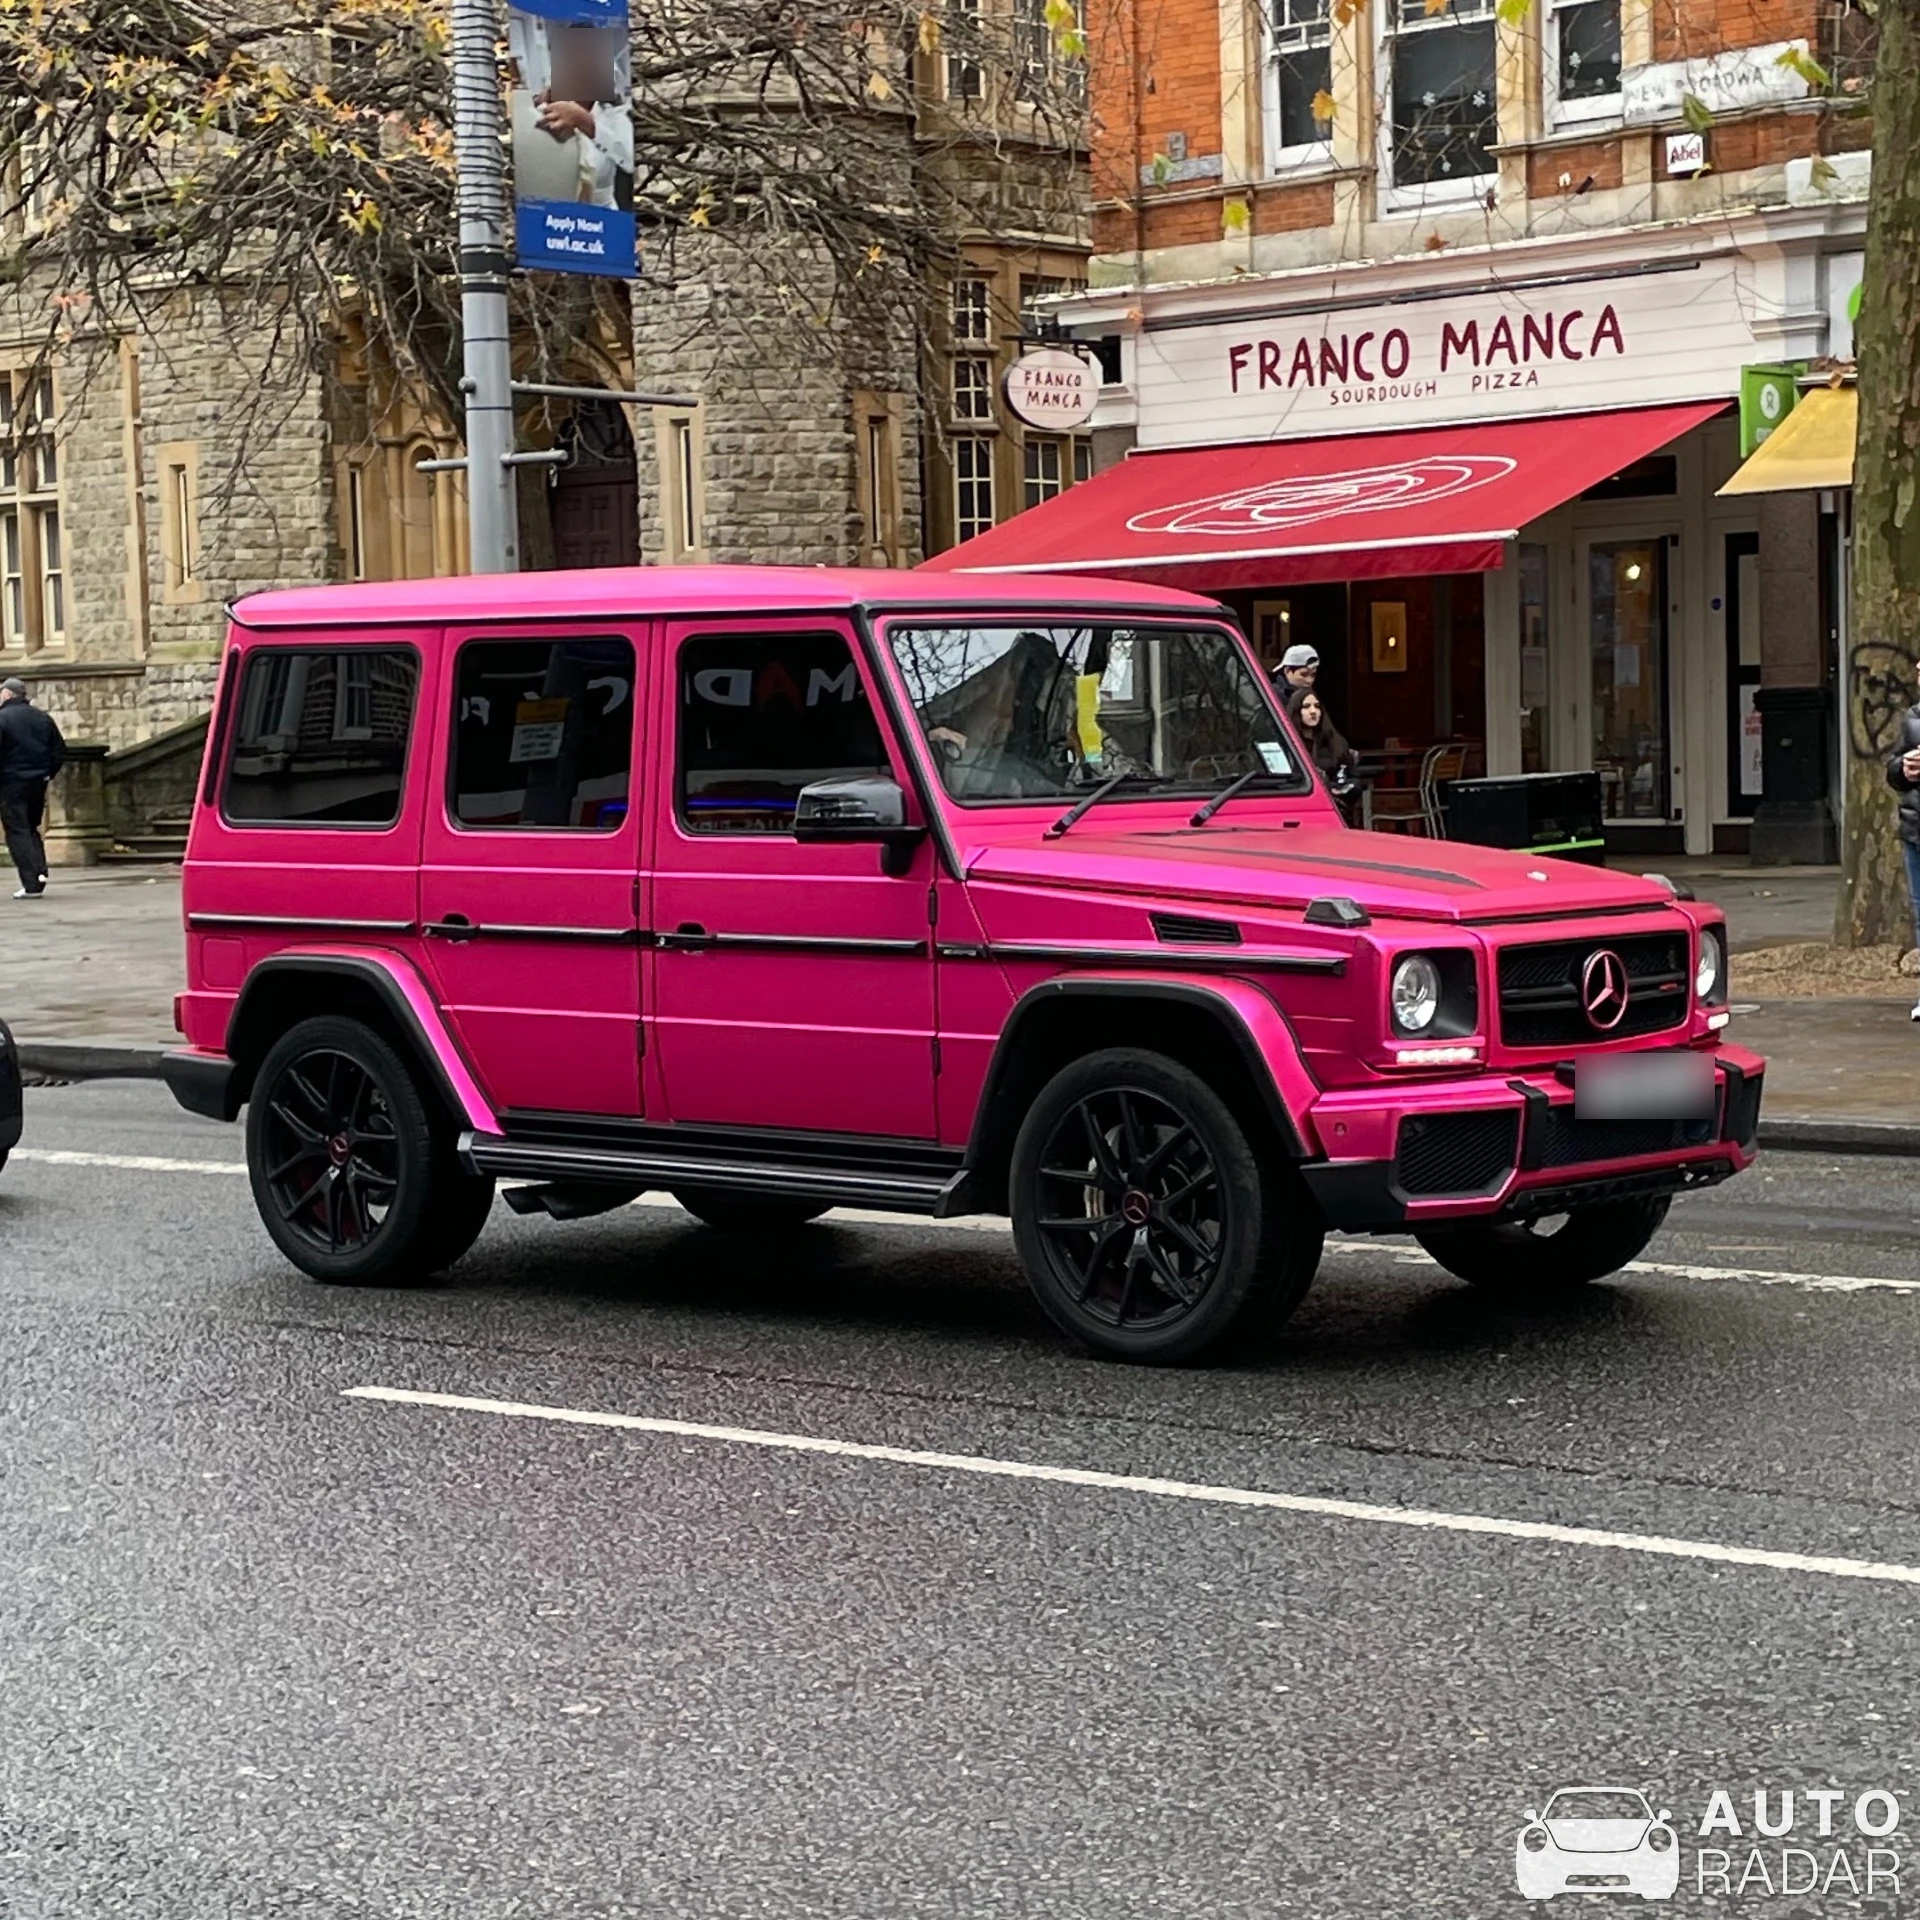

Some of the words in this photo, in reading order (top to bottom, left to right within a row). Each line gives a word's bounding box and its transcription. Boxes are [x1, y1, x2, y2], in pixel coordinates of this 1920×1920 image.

[1670, 141, 1700, 163] Abel
[546, 214, 576, 233] Apply
[546, 236, 605, 254] uwl.ac.uk
[1228, 328, 1410, 393] FRANCO
[1441, 304, 1624, 373] MANCA
[1024, 370, 1082, 387] FRANCO
[1330, 380, 1438, 406] SOURDOUGH
[1472, 370, 1539, 393] PIZZA
[1026, 390, 1082, 408] MANCA
